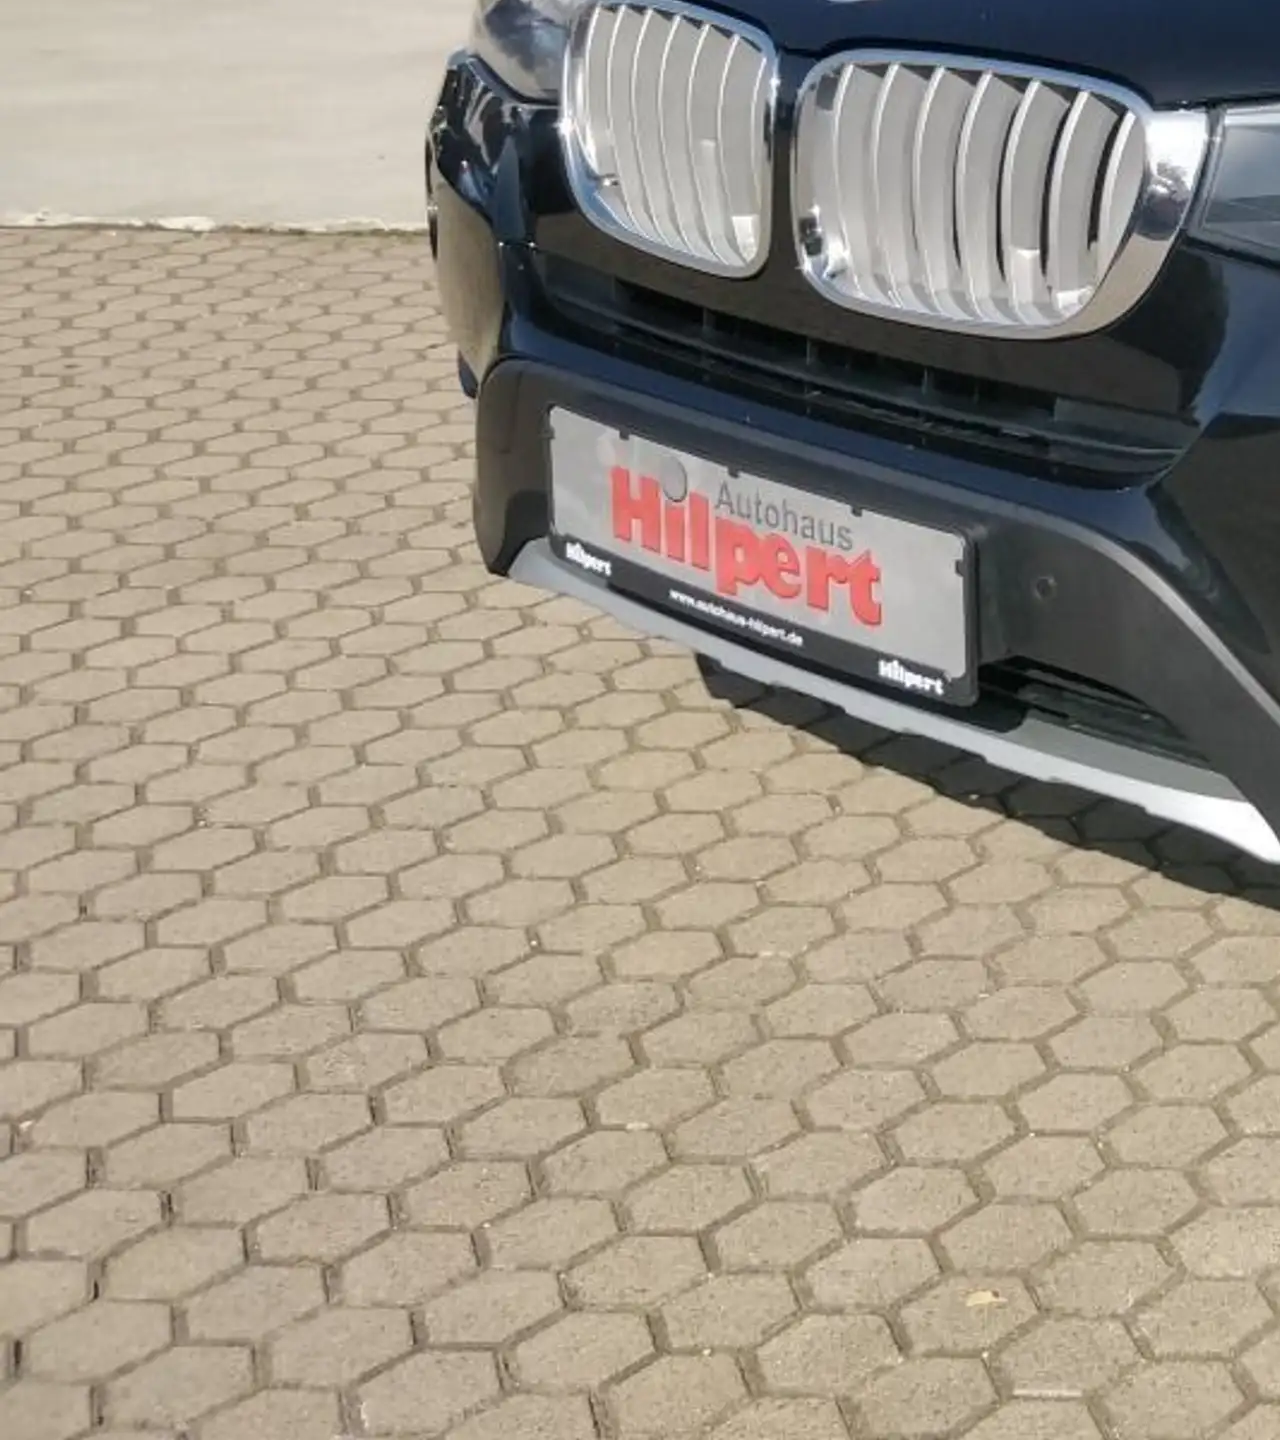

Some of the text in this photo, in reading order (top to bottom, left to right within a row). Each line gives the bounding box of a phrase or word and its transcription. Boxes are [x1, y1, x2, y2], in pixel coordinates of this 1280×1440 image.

[610, 457, 882, 626] Hilpert
[715, 480, 854, 551] Autohaus
[878, 659, 944, 695] Hilpert
